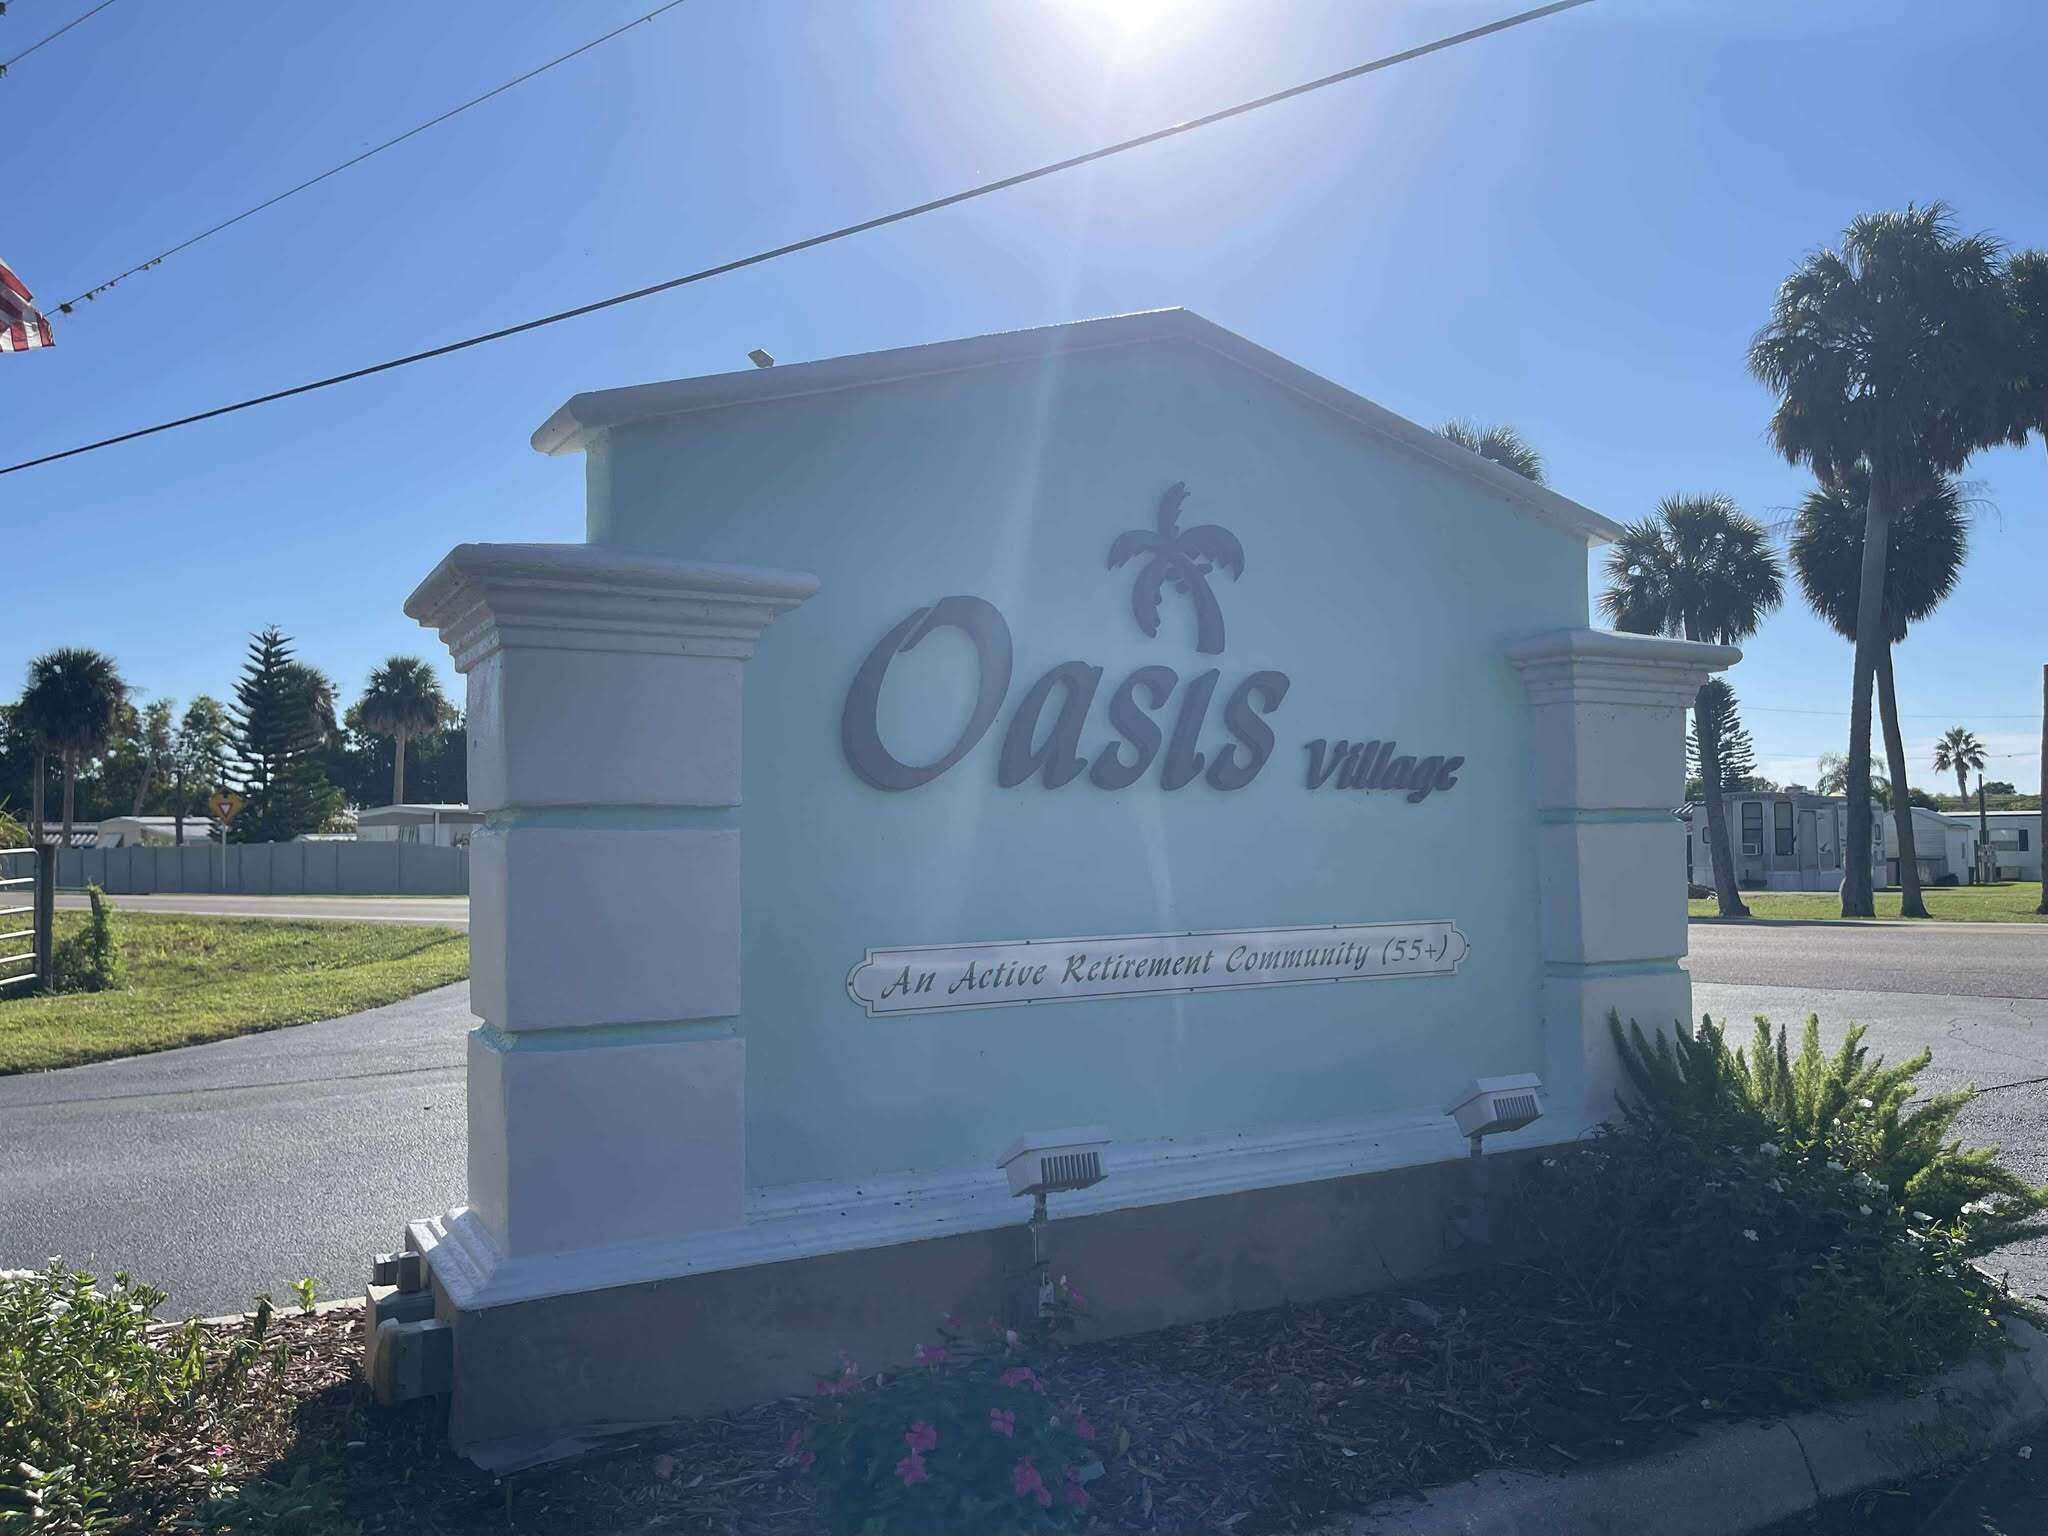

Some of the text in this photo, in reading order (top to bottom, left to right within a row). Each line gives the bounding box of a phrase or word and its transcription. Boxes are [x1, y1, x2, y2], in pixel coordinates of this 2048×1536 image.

[841, 595, 1465, 804] Oasis Village
[880, 934, 1447, 999] An Active Retirement Community (55+)
